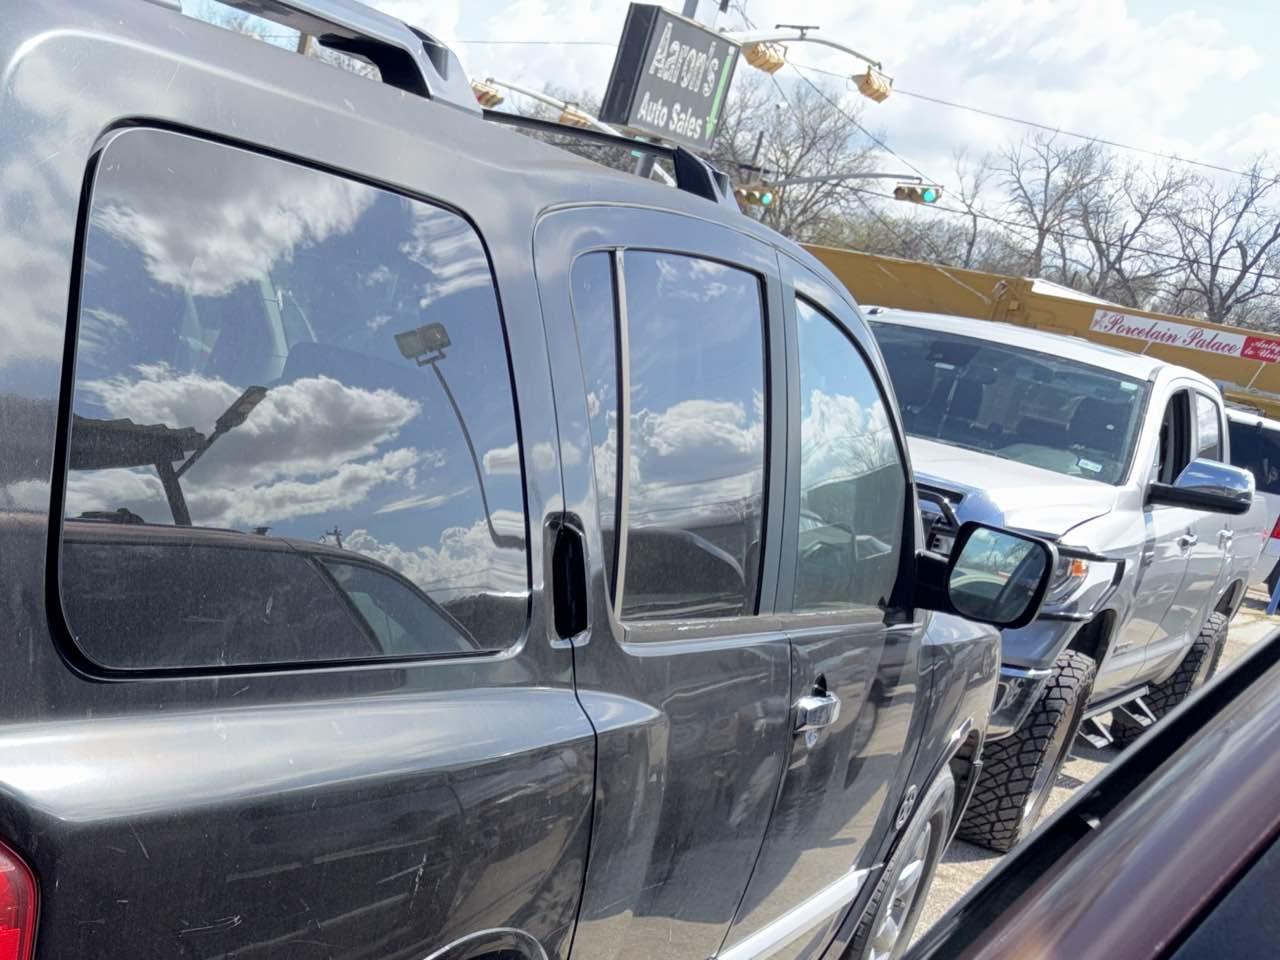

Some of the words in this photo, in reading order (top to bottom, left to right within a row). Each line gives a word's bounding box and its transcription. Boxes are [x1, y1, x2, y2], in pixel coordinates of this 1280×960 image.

[648, 22, 719, 97] Aaron's
[637, 91, 668, 127] Auto
[669, 102, 702, 139] Sales
[1103, 313, 1179, 345] Porcelain
[1182, 327, 1240, 354] Palace
